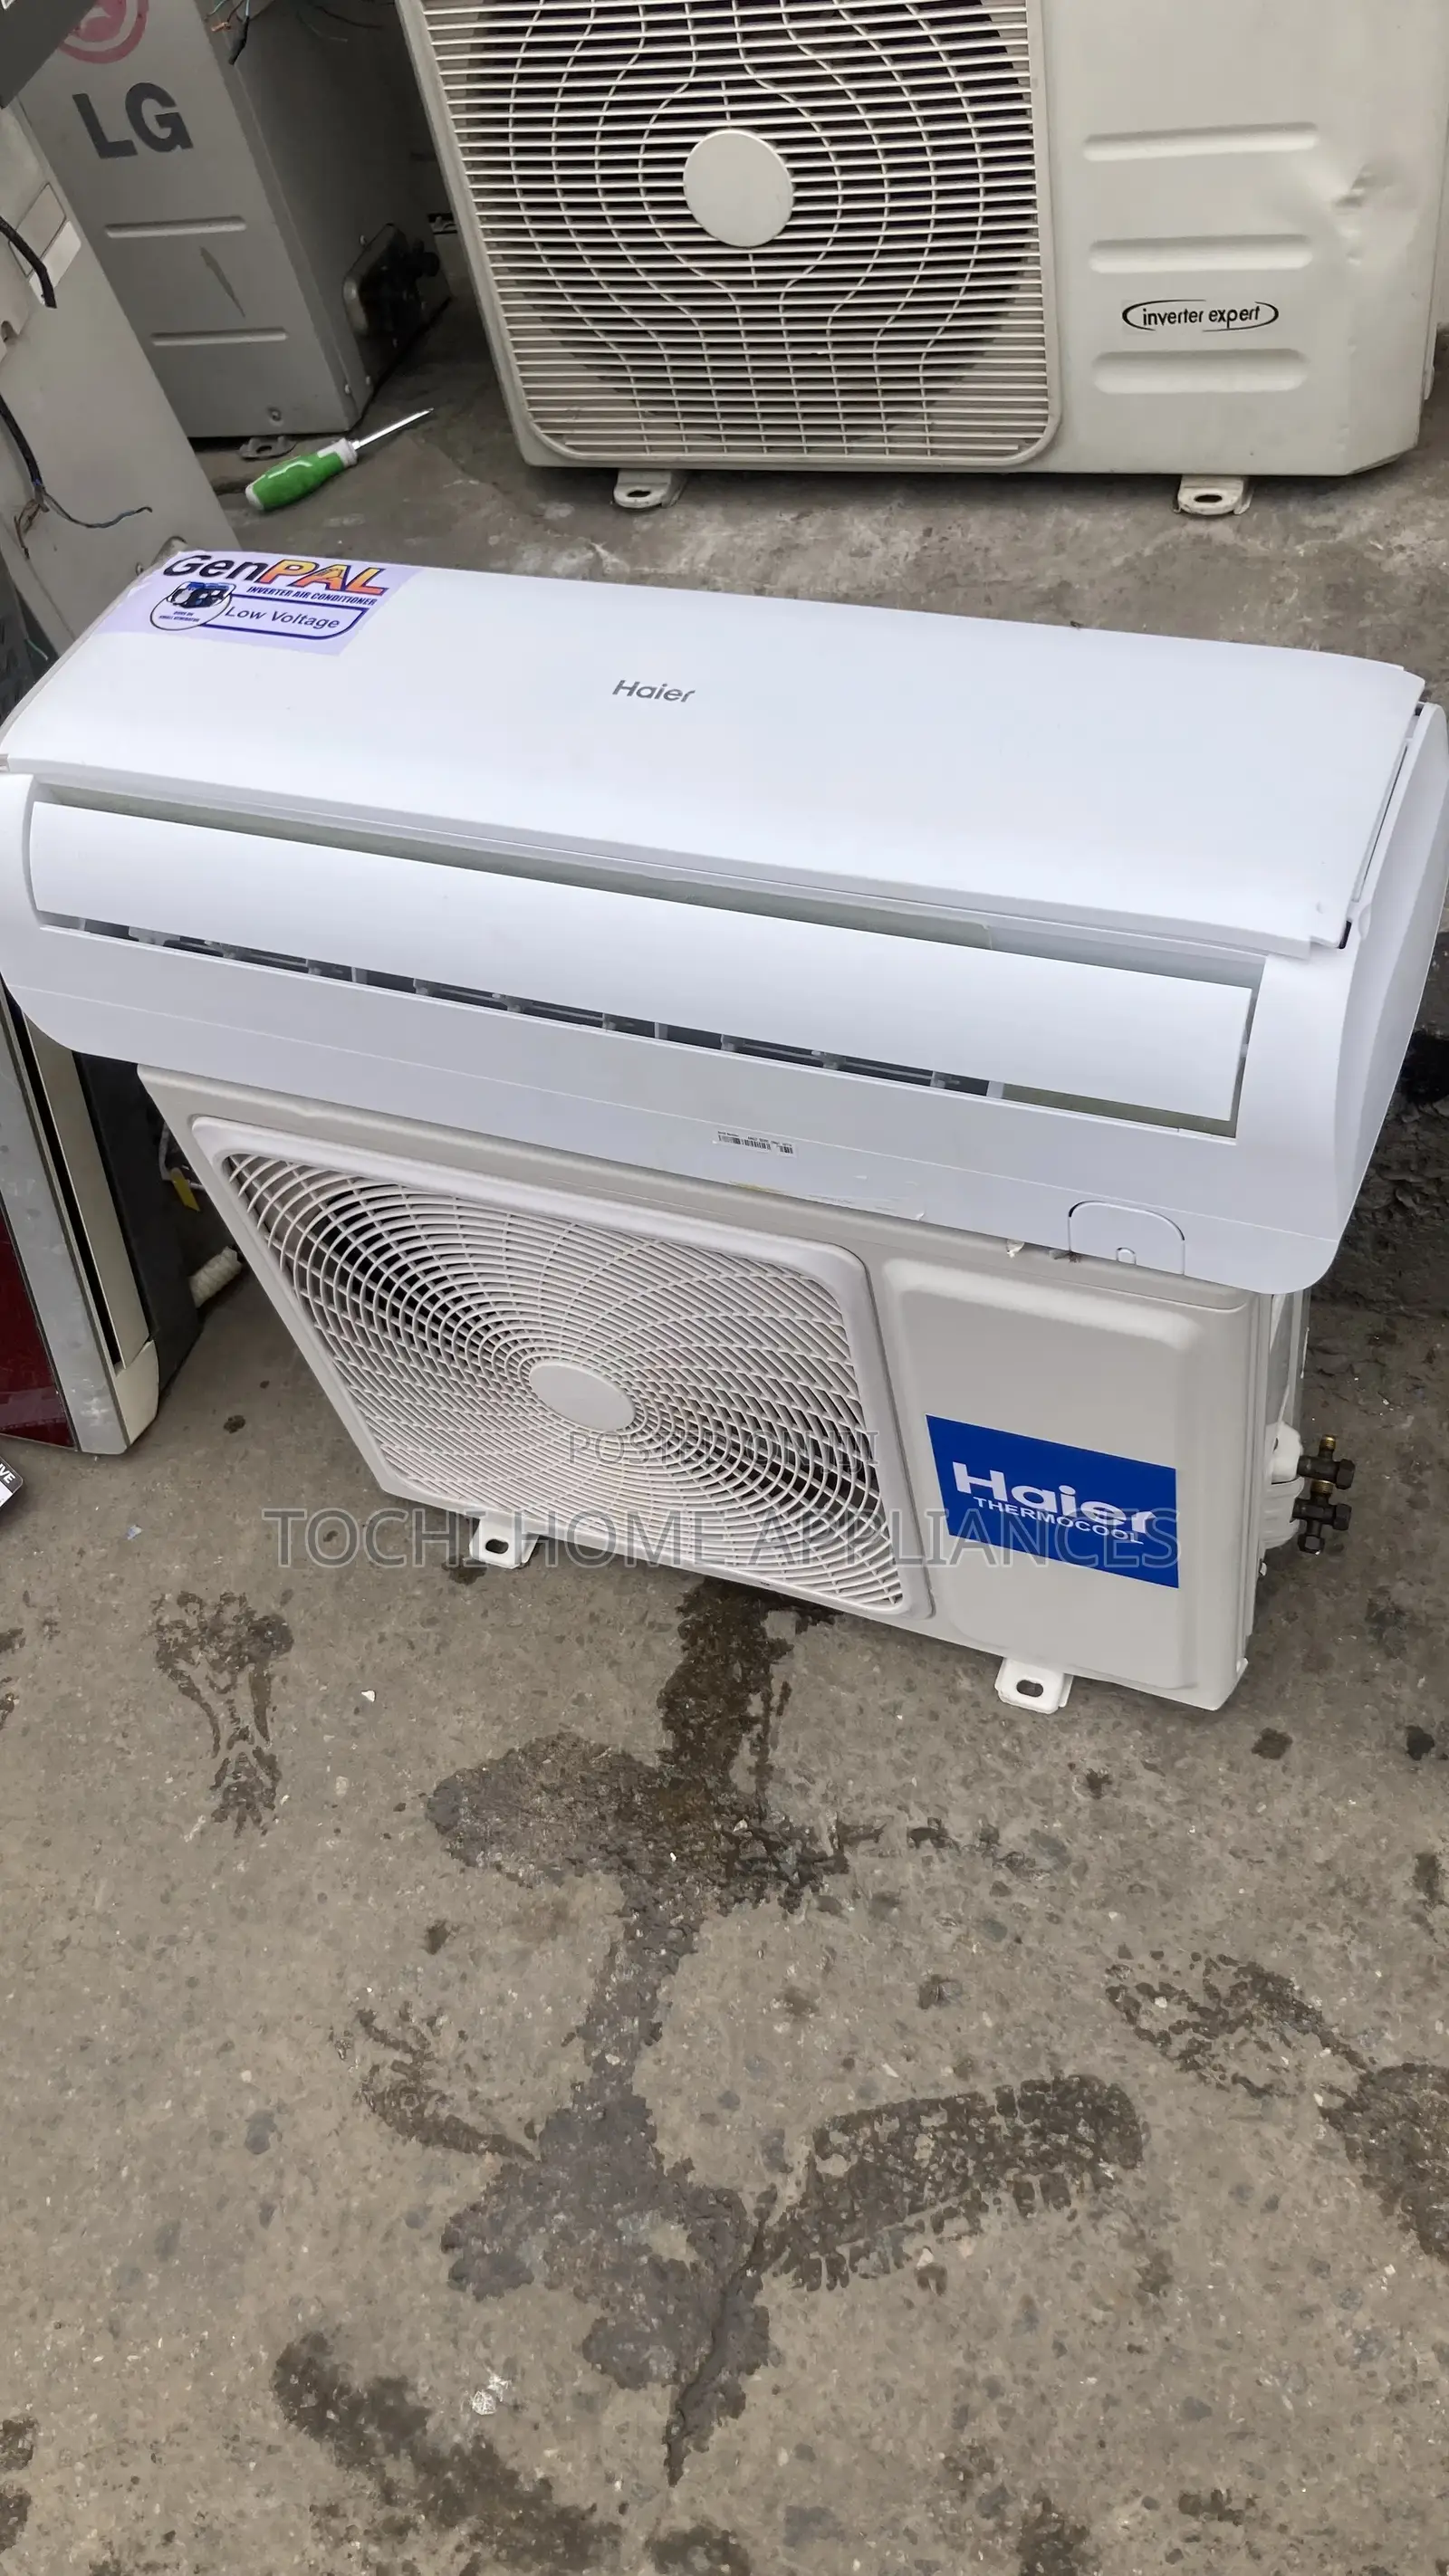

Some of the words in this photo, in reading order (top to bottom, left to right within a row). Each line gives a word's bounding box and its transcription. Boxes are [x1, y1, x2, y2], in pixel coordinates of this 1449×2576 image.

[72, 82, 194, 159] LG
[1142, 308, 1204, 326] inverter
[1208, 306, 1261, 329] expert
[163, 554, 389, 597] GenPAL
[246, 586, 293, 598] INVERTER
[293, 590, 311, 599] AIR
[311, 592, 378, 606] CONDITIONER
[226, 606, 266, 620] Low
[271, 610, 341, 629] Voltage
[612, 680, 696, 703] Haier
[953, 1461, 1156, 1534] Haier
[973, 1496, 1144, 1545] THERMOCOOL
